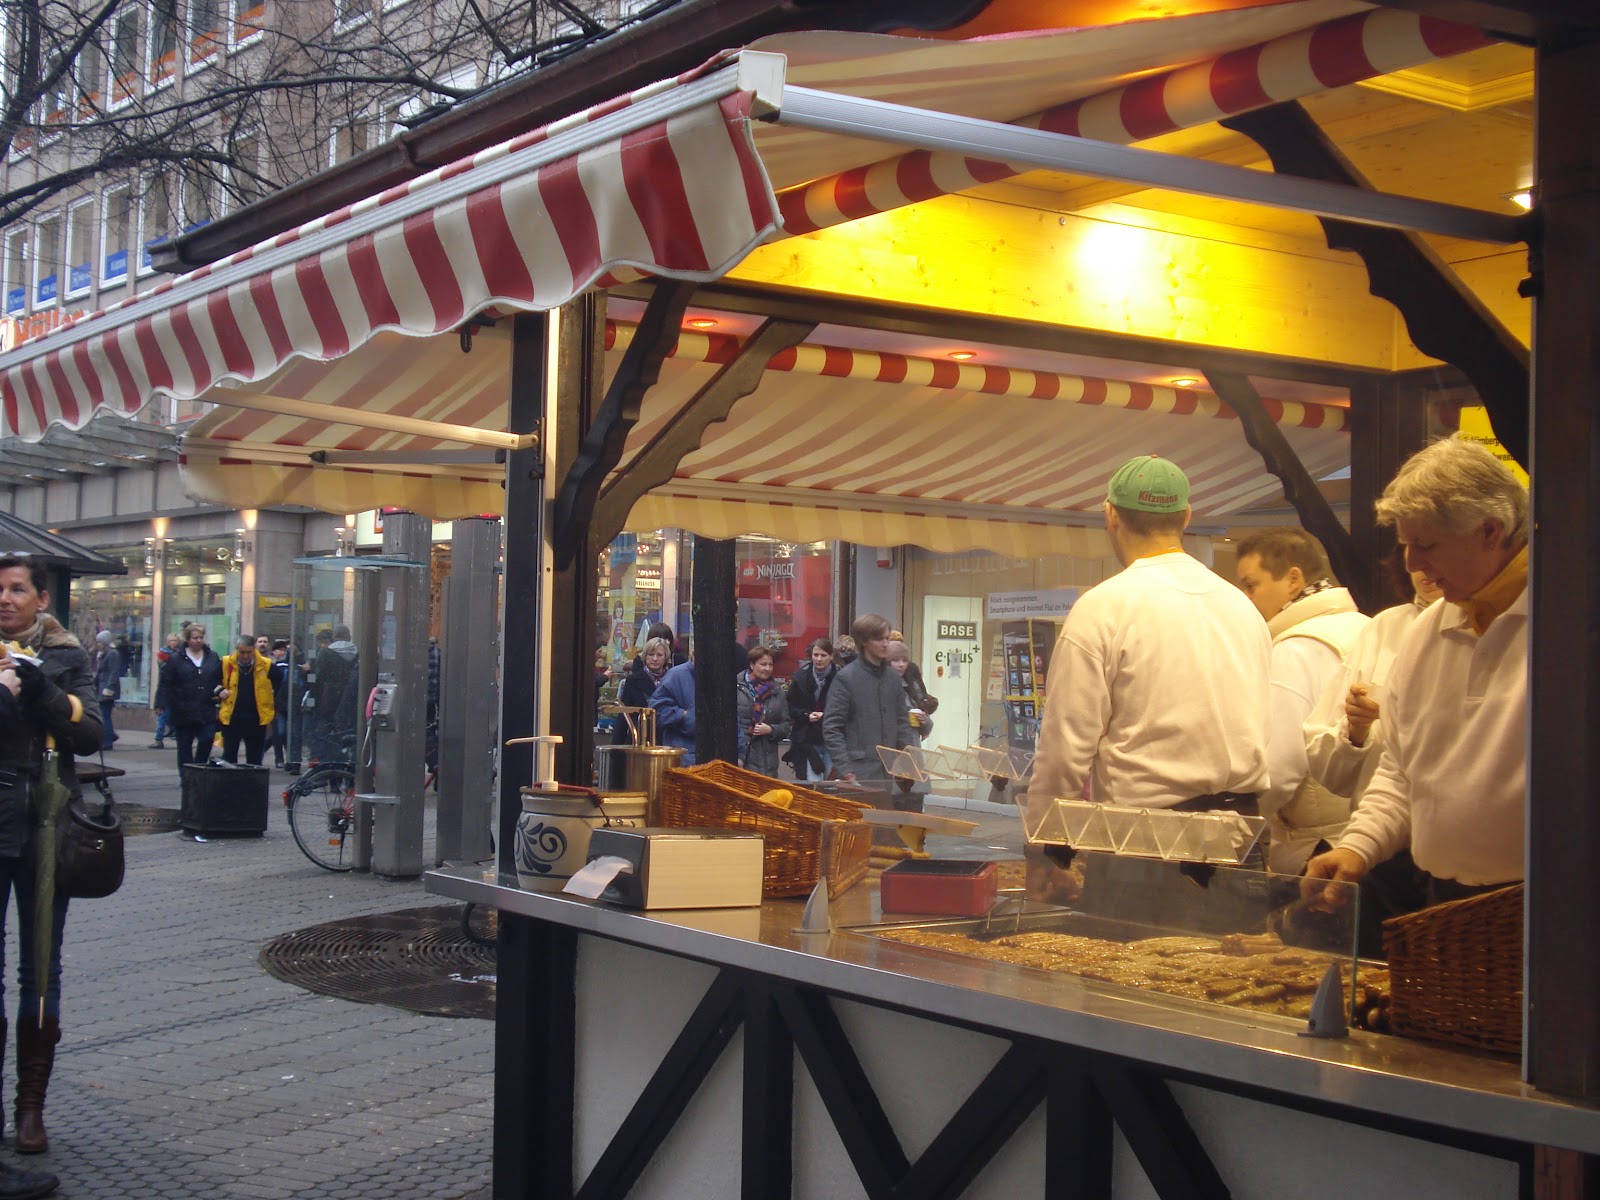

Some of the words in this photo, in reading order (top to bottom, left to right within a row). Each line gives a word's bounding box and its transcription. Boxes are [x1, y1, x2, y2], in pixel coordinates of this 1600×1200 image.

[1138, 490, 1179, 504] Kitzmann
[756, 563, 795, 580] NINJAGO
[941, 625, 974, 636] BASE
